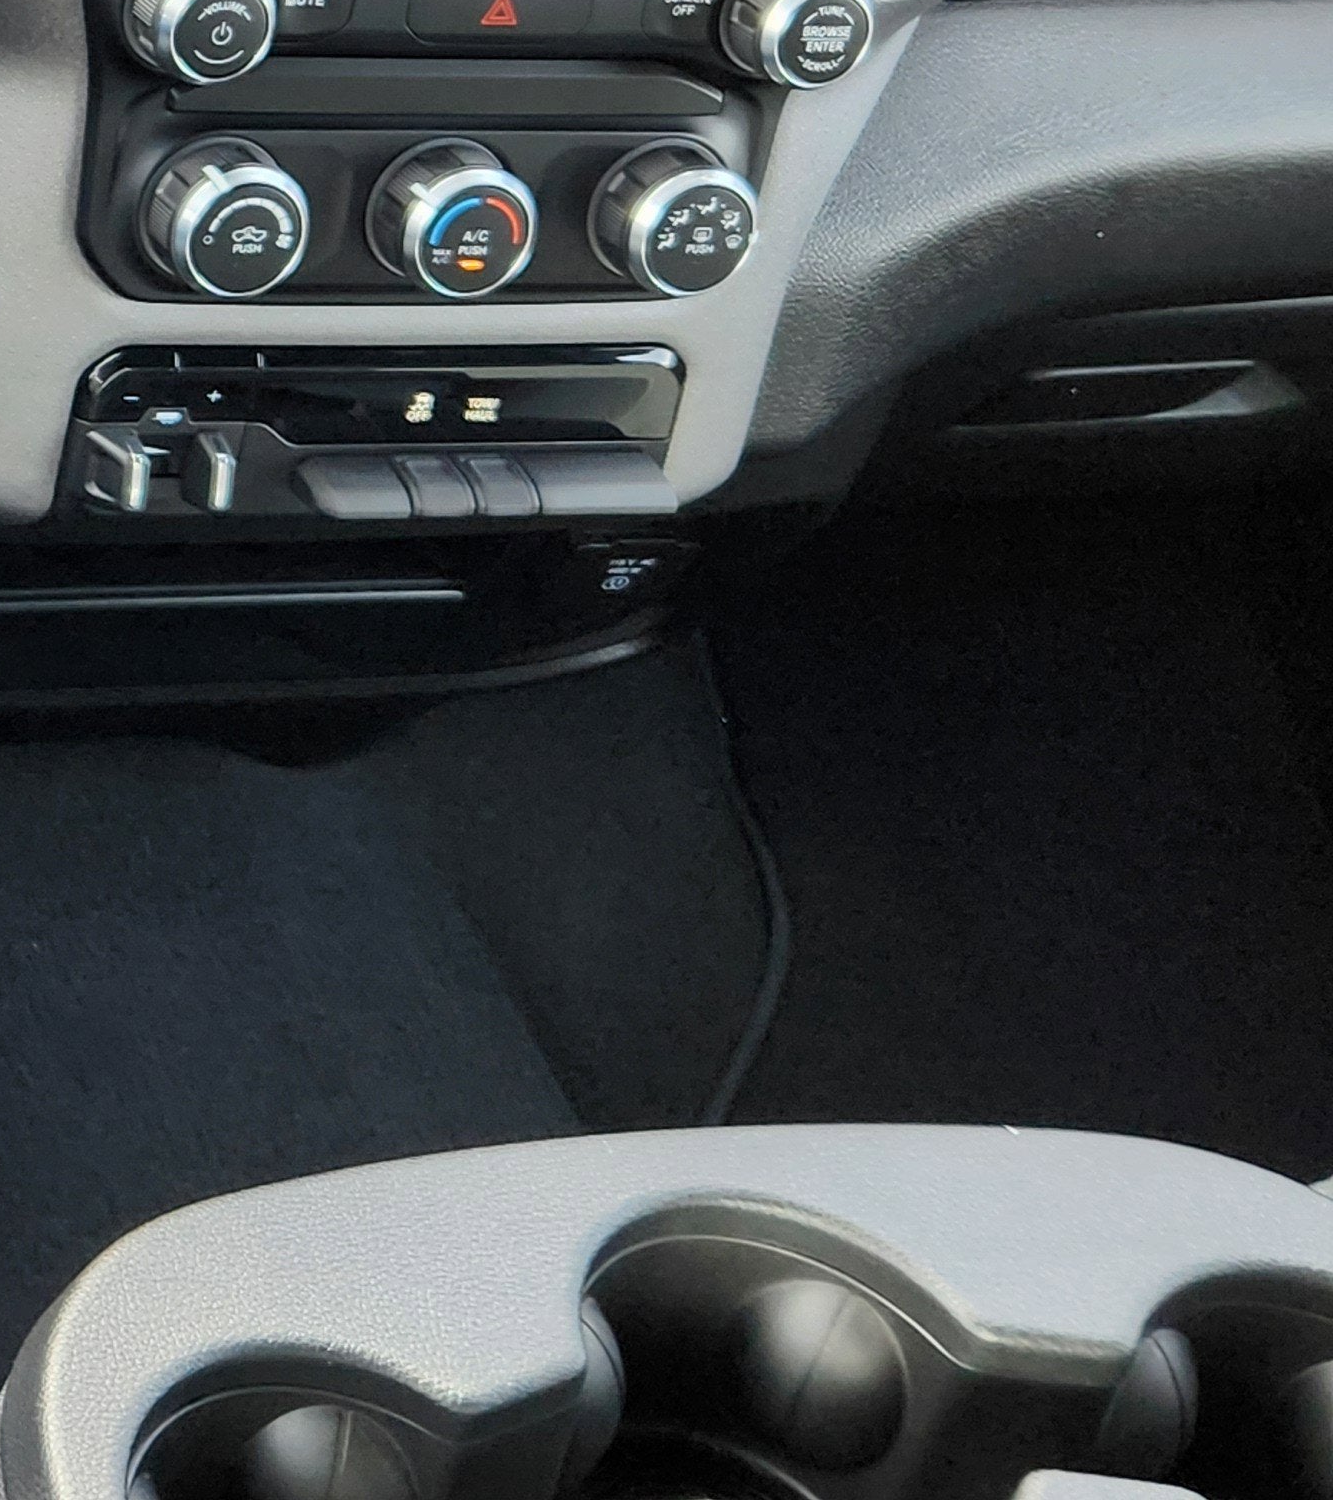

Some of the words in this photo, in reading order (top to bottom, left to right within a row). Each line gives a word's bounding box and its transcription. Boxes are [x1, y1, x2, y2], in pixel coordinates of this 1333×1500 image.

[203, 0, 248, 16] VOLUME
[671, 5, 696, 17] OFF
[818, 6, 846, 18] TUNE
[802, 25, 852, 39] BROWSE
[805, 41, 846, 53] ENTER
[801, 59, 840, 73] SCROLL
[462, 228, 489, 242] A/C
[232, 243, 262, 254] PUSH
[457, 245, 488, 256] PUSH
[685, 243, 714, 255] PUSH
